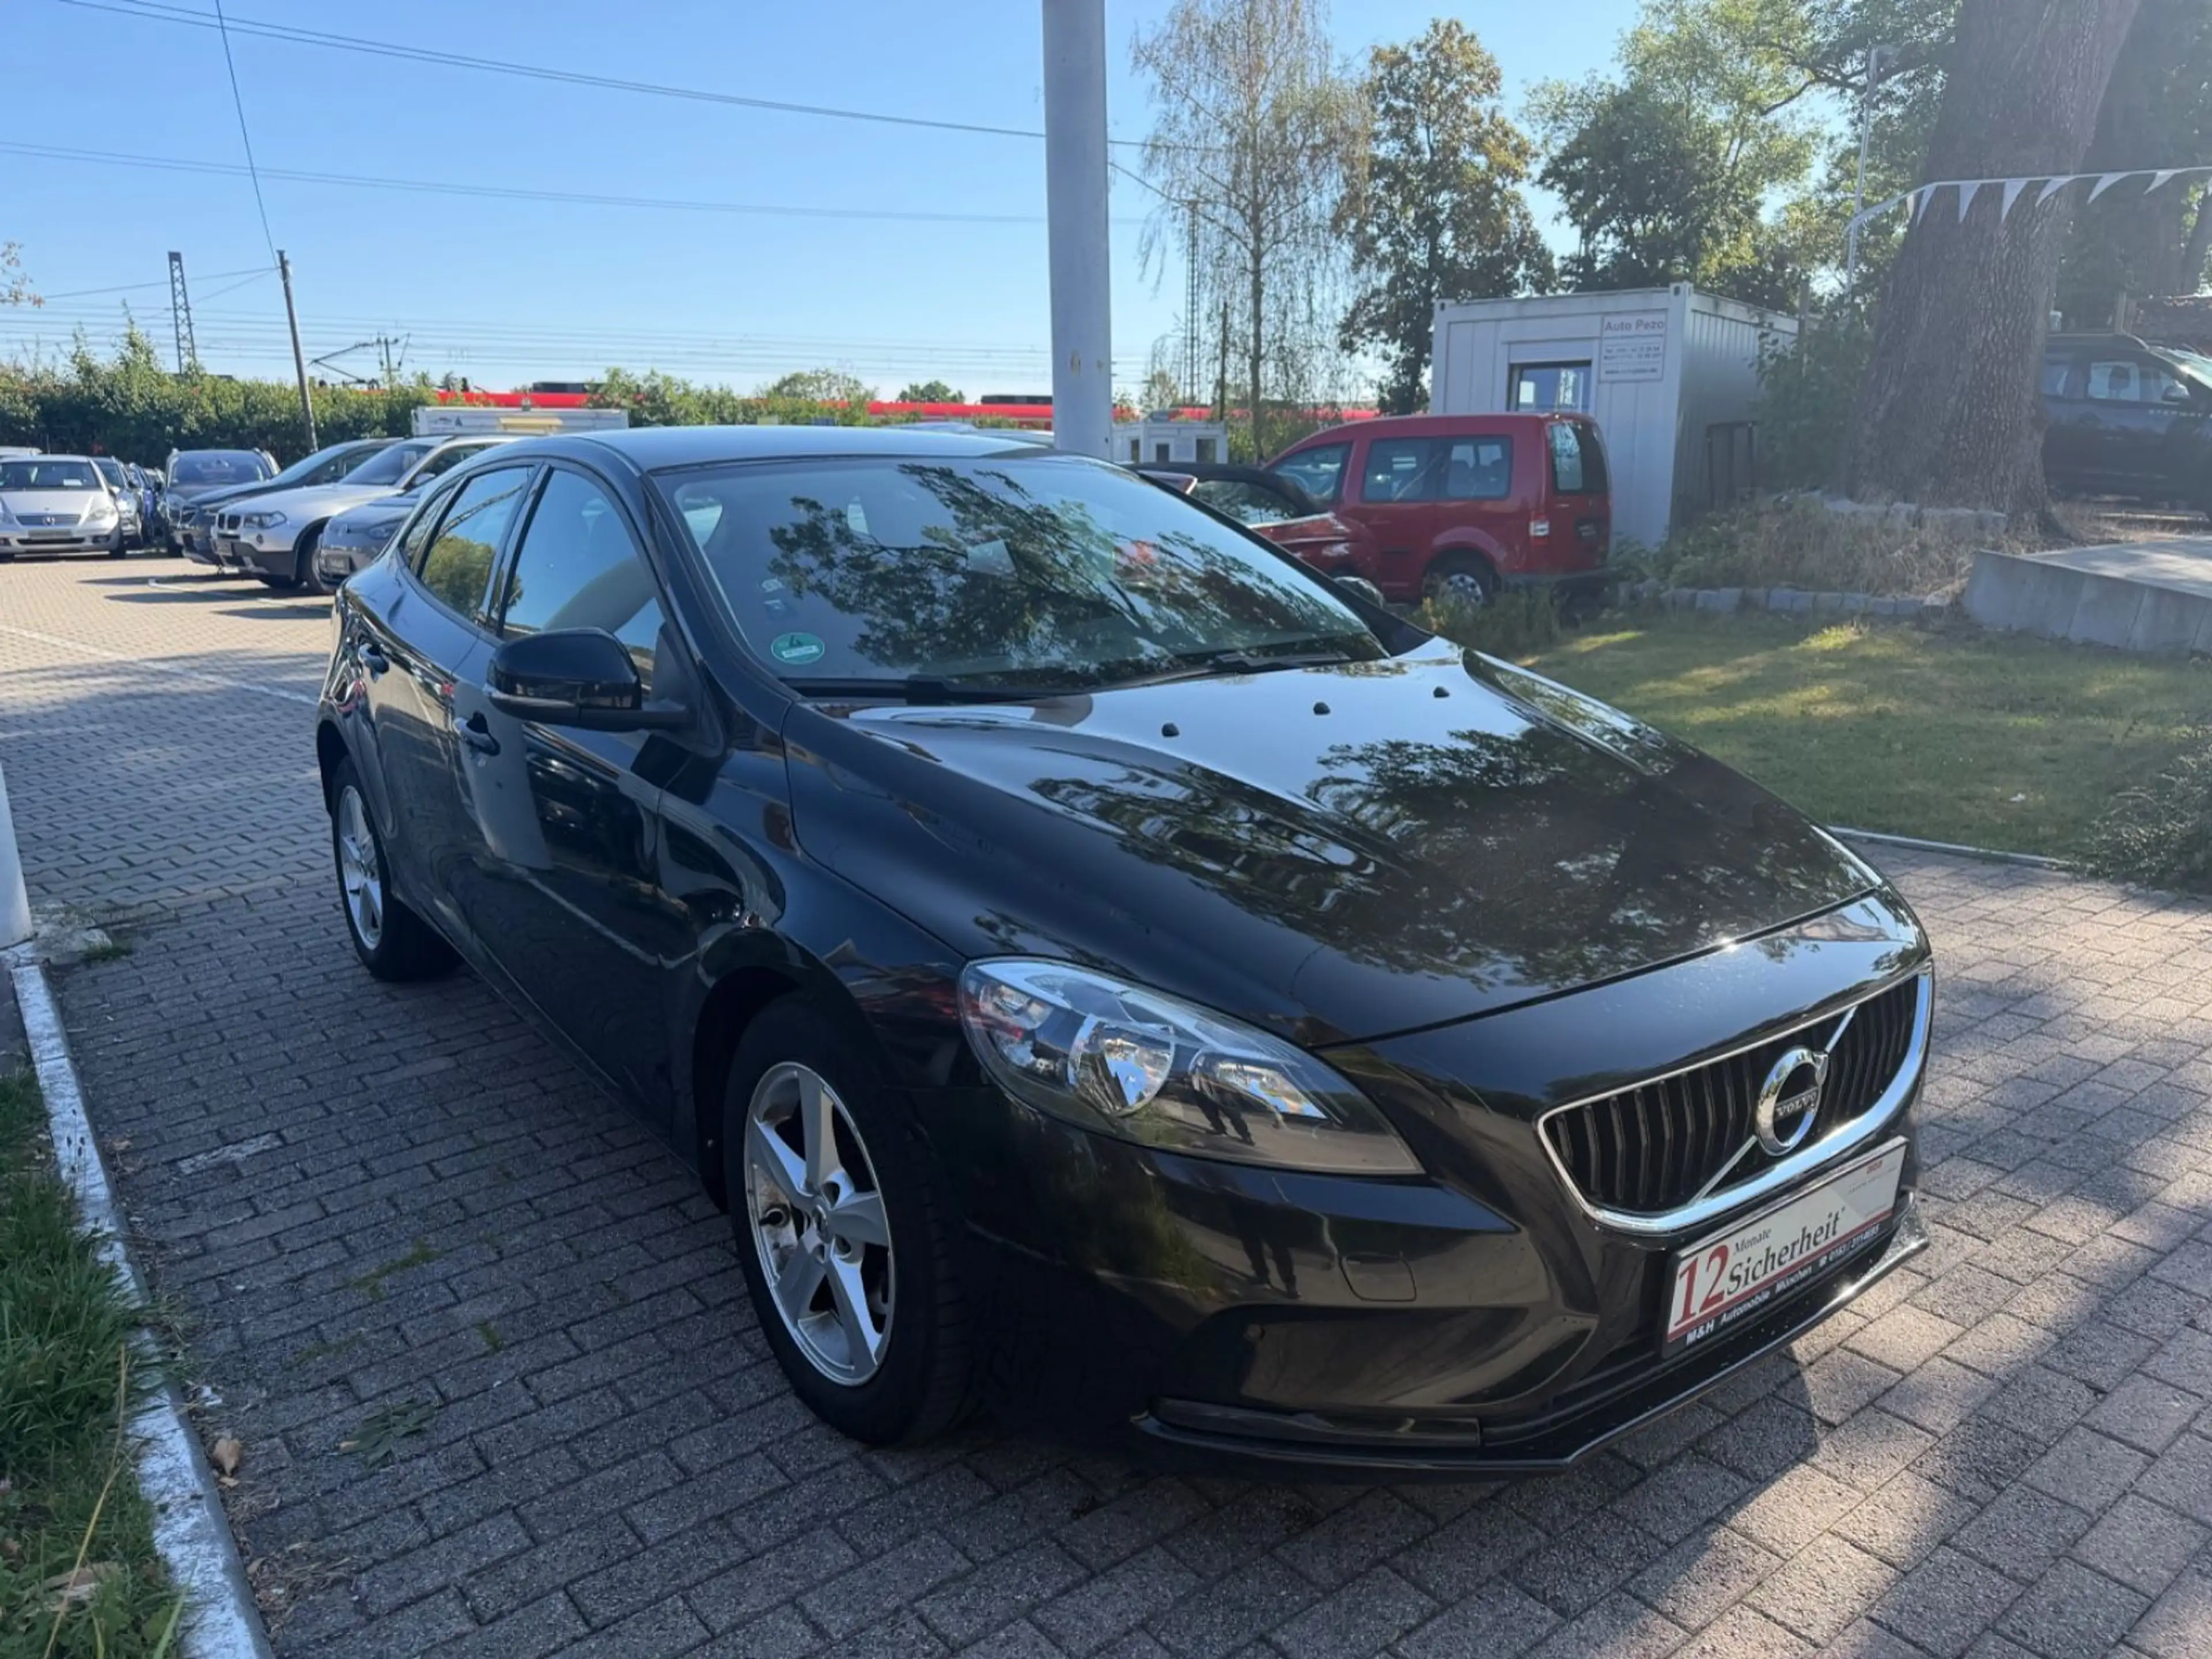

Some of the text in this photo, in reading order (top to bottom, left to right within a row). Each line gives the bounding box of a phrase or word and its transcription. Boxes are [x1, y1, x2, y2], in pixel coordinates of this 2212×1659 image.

[1605, 321, 1632, 331] Auto
[1775, 1092, 1817, 1116] VOLVO
[1727, 1210, 1839, 1295] Sicherheit
[1733, 1228, 1772, 1255] Monate
[1674, 1244, 1730, 1327] 12
[1685, 1319, 1714, 1346] M&H
